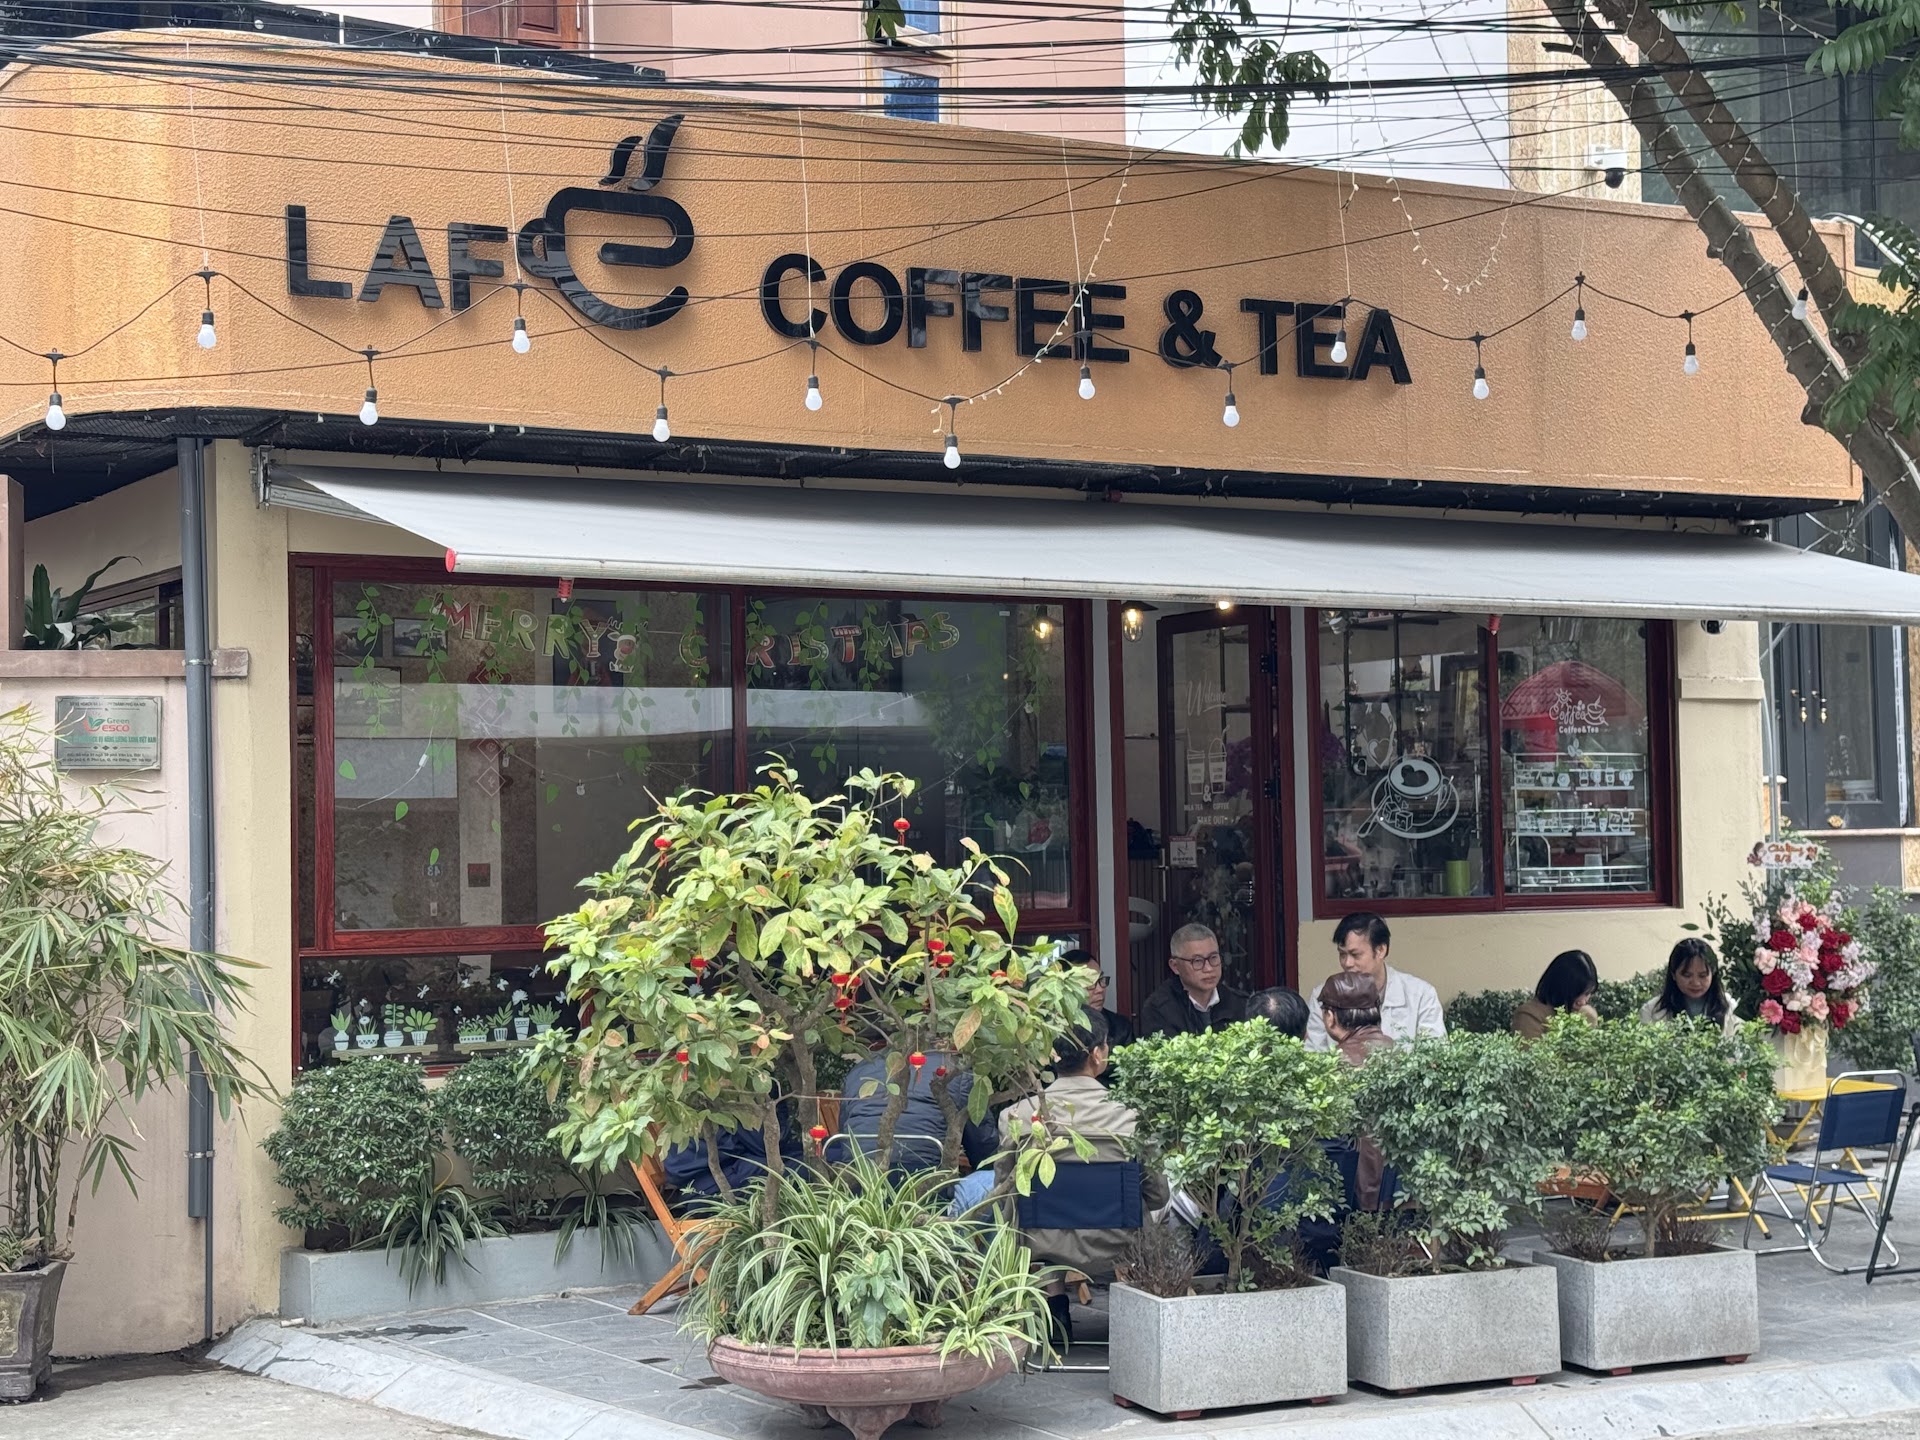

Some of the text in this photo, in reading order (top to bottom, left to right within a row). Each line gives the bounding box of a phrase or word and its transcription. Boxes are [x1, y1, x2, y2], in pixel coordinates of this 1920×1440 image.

[760, 252, 1130, 364] COFFEE
[1159, 289, 1223, 369] &
[1240, 298, 1413, 385] TEA
[430, 597, 960, 669] MERRY CRISTMAS
[1559, 725, 1599, 734] Coffee&Tea
